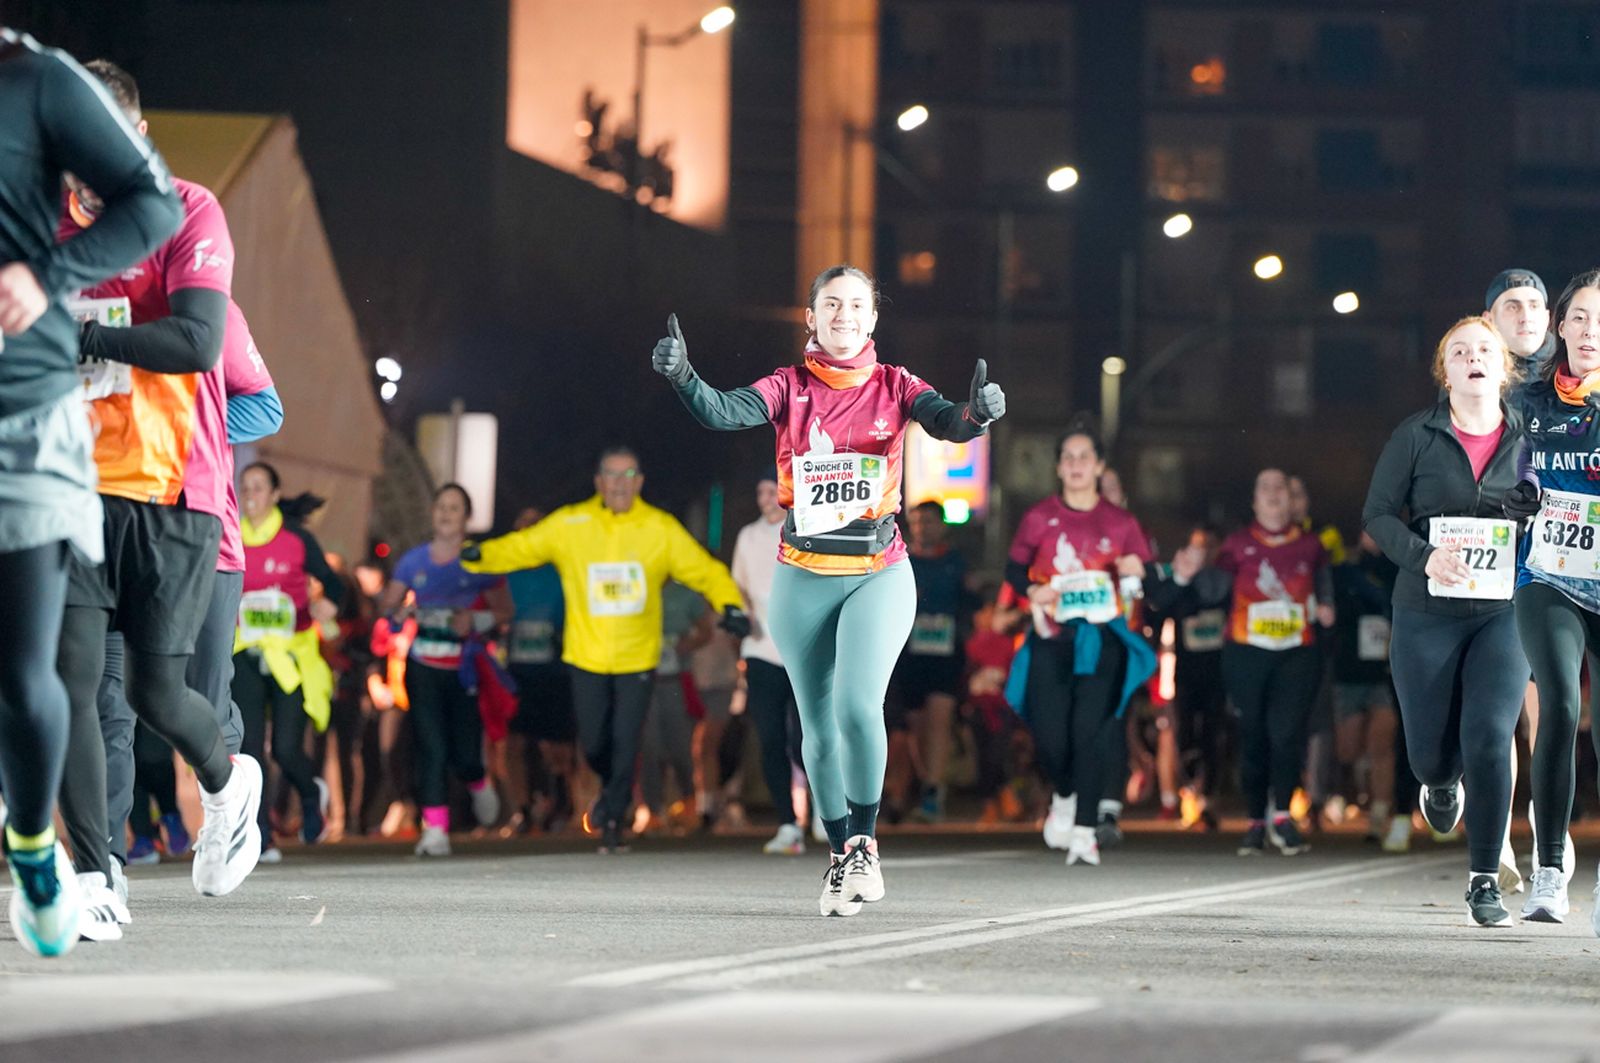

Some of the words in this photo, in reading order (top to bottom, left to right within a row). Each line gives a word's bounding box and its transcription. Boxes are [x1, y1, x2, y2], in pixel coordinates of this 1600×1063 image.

[1552, 448, 1600, 471] ANTÓ
[814, 462, 841, 472] NOCHE
[843, 462, 853, 471] DE
[804, 474, 823, 484] SAN
[811, 480, 871, 506] 2866
[1570, 502, 1581, 511] DE
[1449, 526, 1474, 535] NOCHE
[1543, 520, 1594, 550] 5328
[1440, 537, 1457, 545] SAN
[1457, 547, 1497, 570] 722
